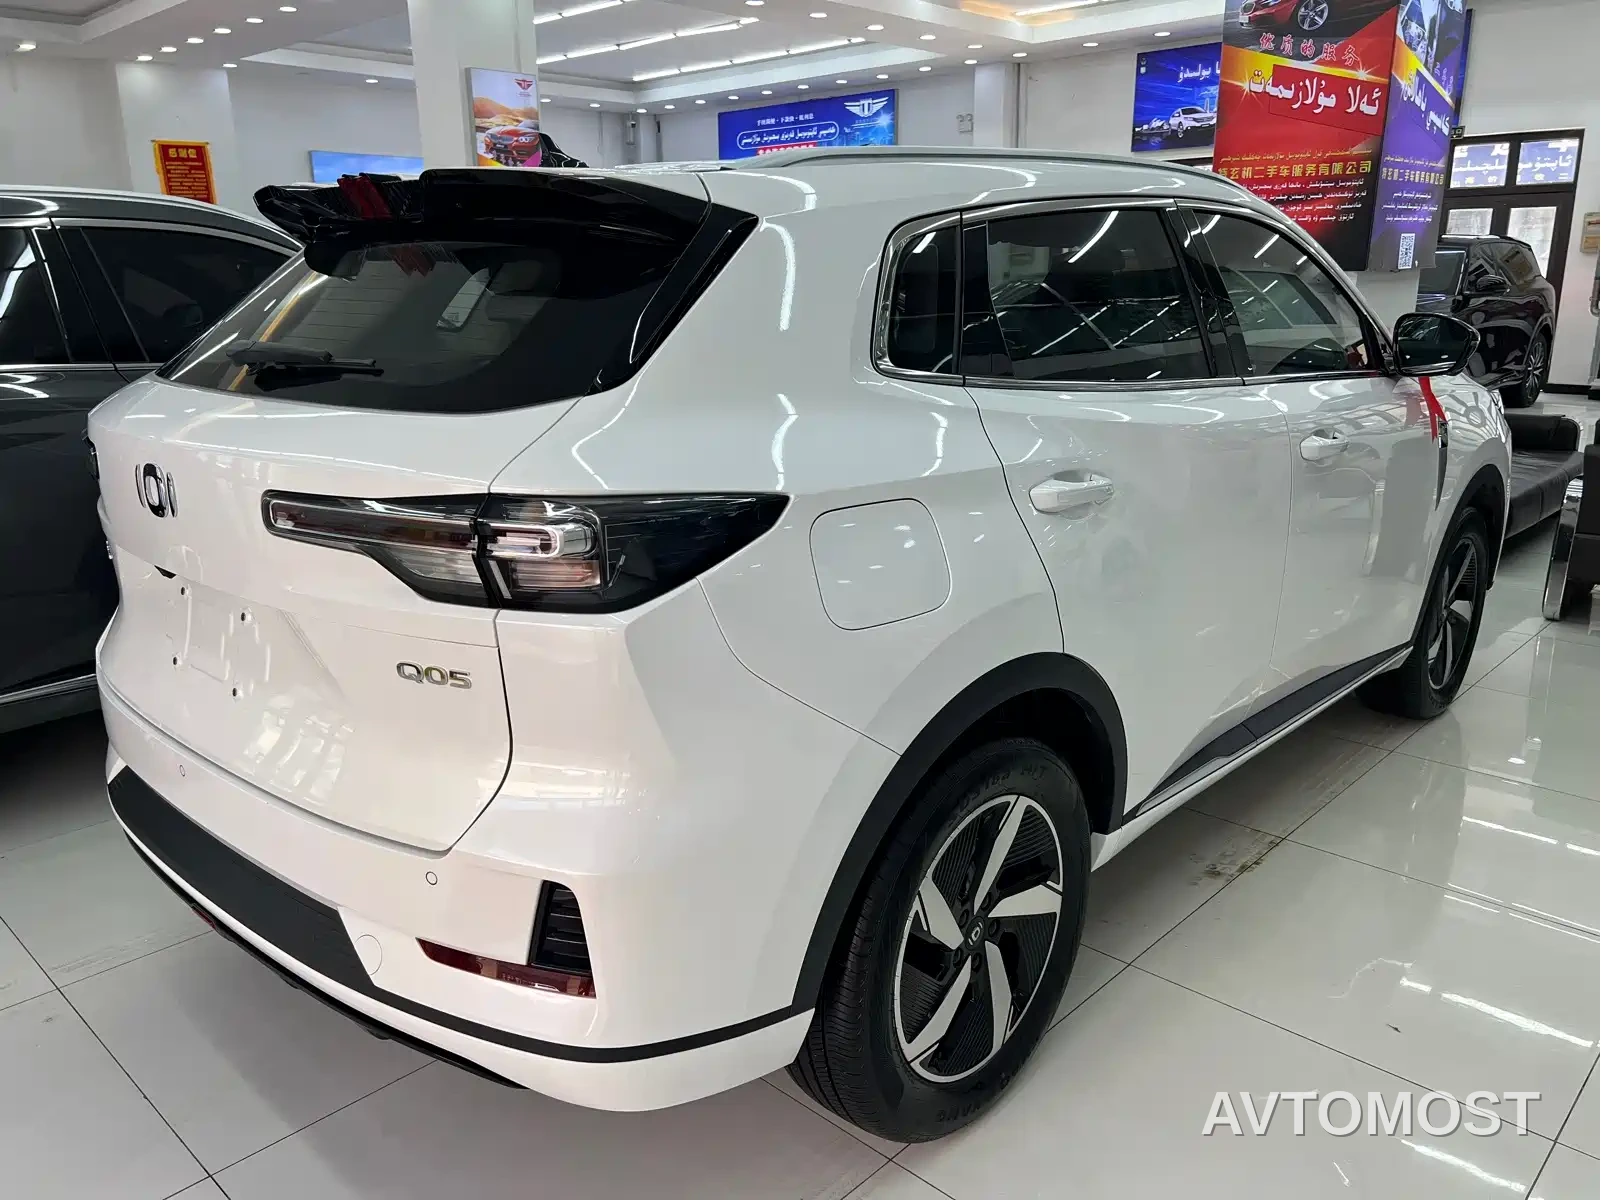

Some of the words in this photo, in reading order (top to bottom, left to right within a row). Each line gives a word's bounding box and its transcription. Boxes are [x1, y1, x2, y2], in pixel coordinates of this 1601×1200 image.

[1259, 32, 1361, 67] 优质的服务
[1249, 69, 1337, 114] مۇلازىمەت
[1345, 84, 1383, 116] ئەلا
[395, 660, 472, 689] Q05
